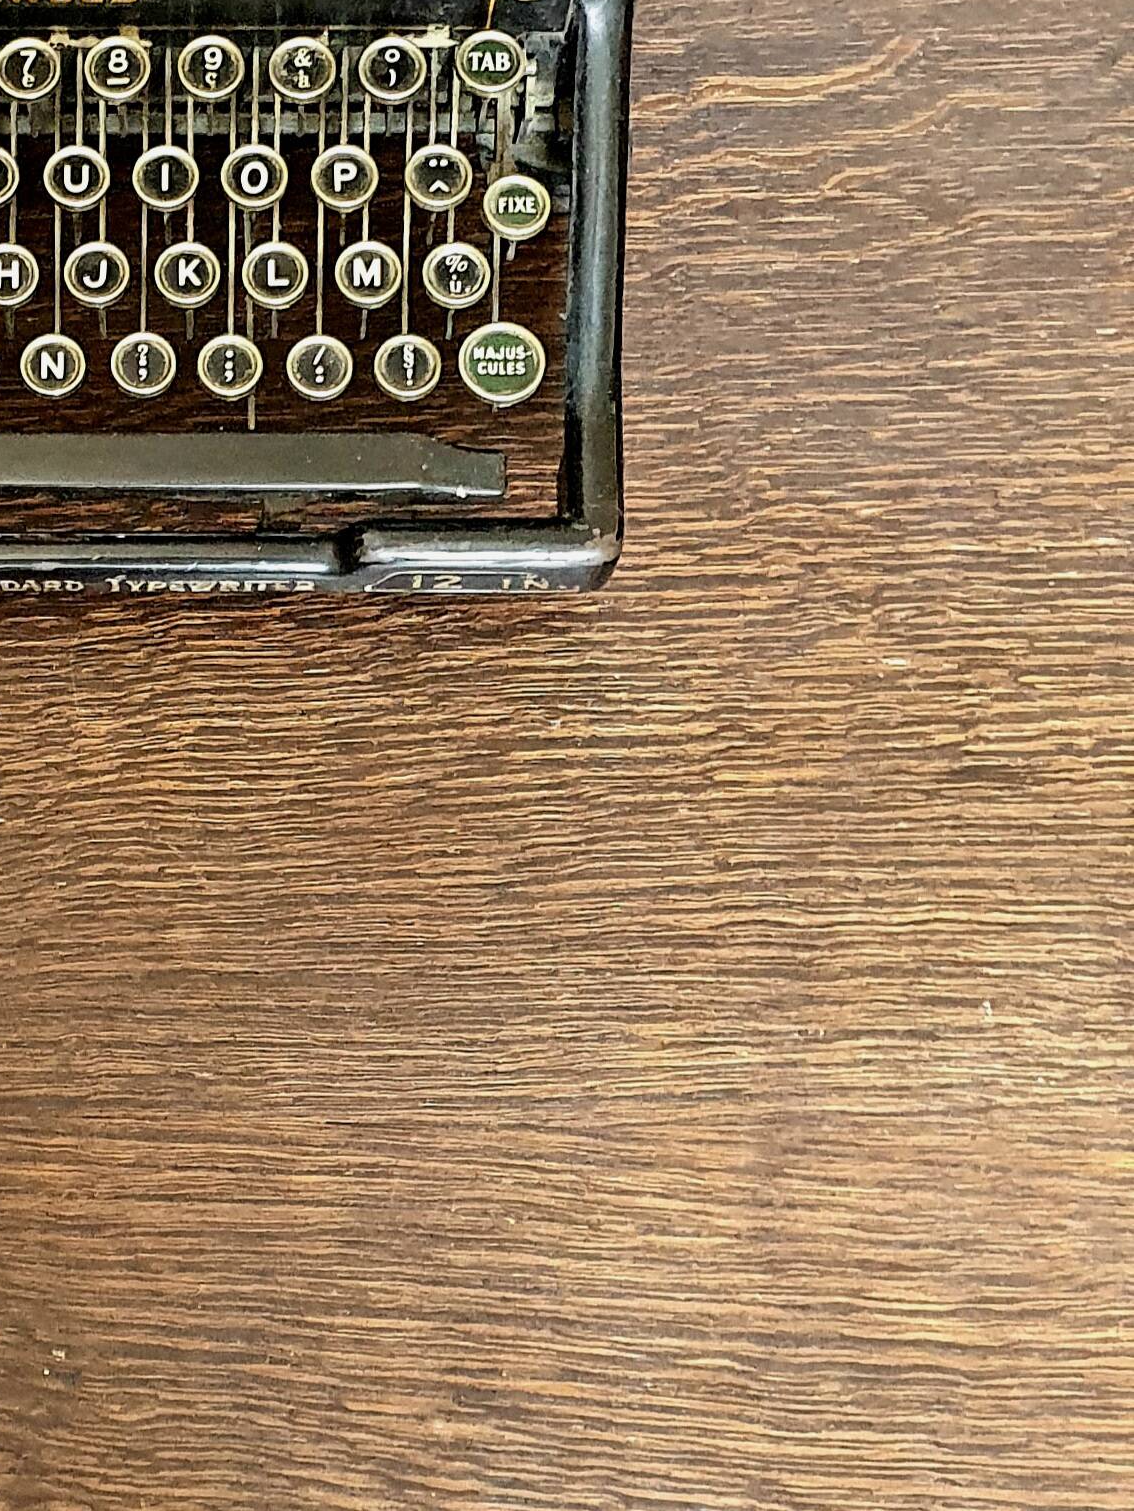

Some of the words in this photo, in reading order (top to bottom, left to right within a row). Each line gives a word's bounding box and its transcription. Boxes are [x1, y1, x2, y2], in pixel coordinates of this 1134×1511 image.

[19, 49, 37, 74] 7
[108, 48, 129, 74] 8
[204, 46, 223, 70] 9
[293, 47, 313, 68] &
[468, 50, 511, 73] TAB
[63, 164, 90, 193] U
[161, 162, 170, 192] I
[240, 161, 269, 195] O
[333, 162, 358, 192] P
[498, 195, 537, 214] FIXE
[82, 259, 108, 289] J
[178, 258, 202, 286] K
[267, 258, 290, 287] L
[353, 256, 381, 287] M
[445, 254, 469, 273] %
[40, 350, 65, 380] N
[312, 346, 326, 366] /
[472, 344, 534, 361] MAJUS-
[476, 361, 526, 376] CULES
[105, 574, 316, 593] TYPEWRITER
[412, 571, 463, 589] 12
